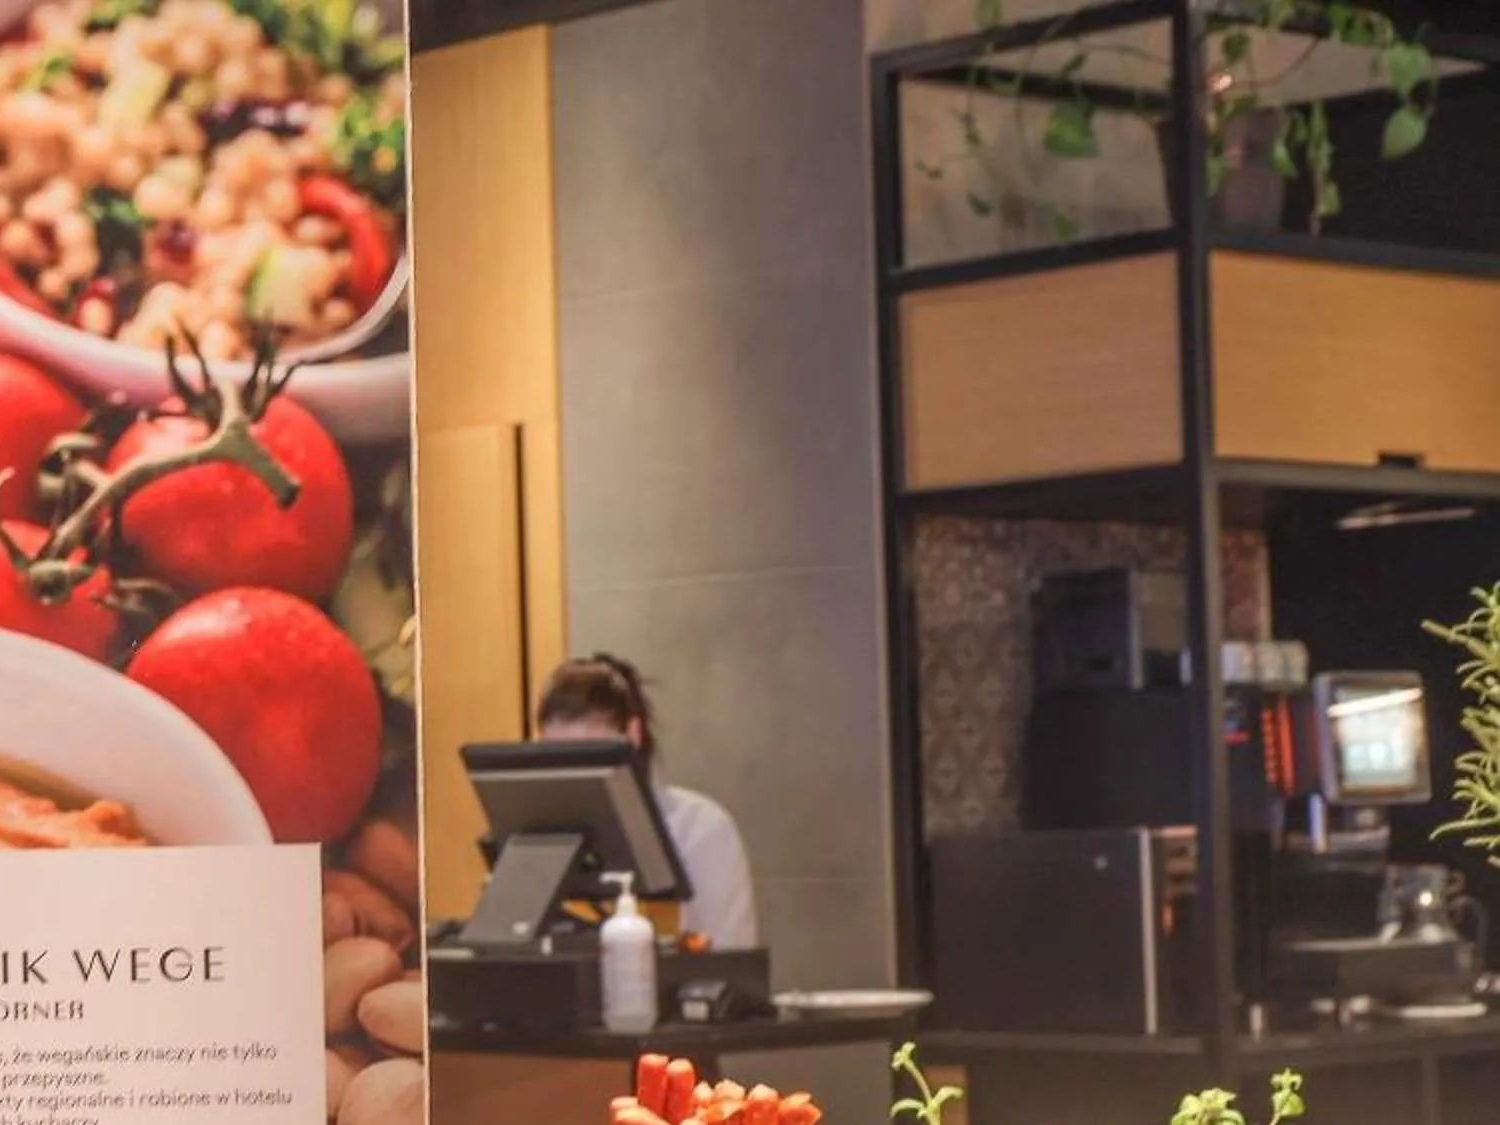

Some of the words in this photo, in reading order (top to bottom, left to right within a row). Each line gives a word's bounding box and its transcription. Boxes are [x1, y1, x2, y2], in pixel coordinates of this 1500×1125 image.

[72, 945, 227, 984] WEGE
[38, 1044, 130, 1065] wegańskie
[135, 1047, 196, 1064] znaczy
[200, 1042, 229, 1060] nie
[233, 1042, 278, 1065] tylko
[28, 1090, 125, 1112] regionalne
[140, 1087, 211, 1107] robione
[216, 1094, 231, 1106] w
[235, 1087, 293, 1106] hotelu
